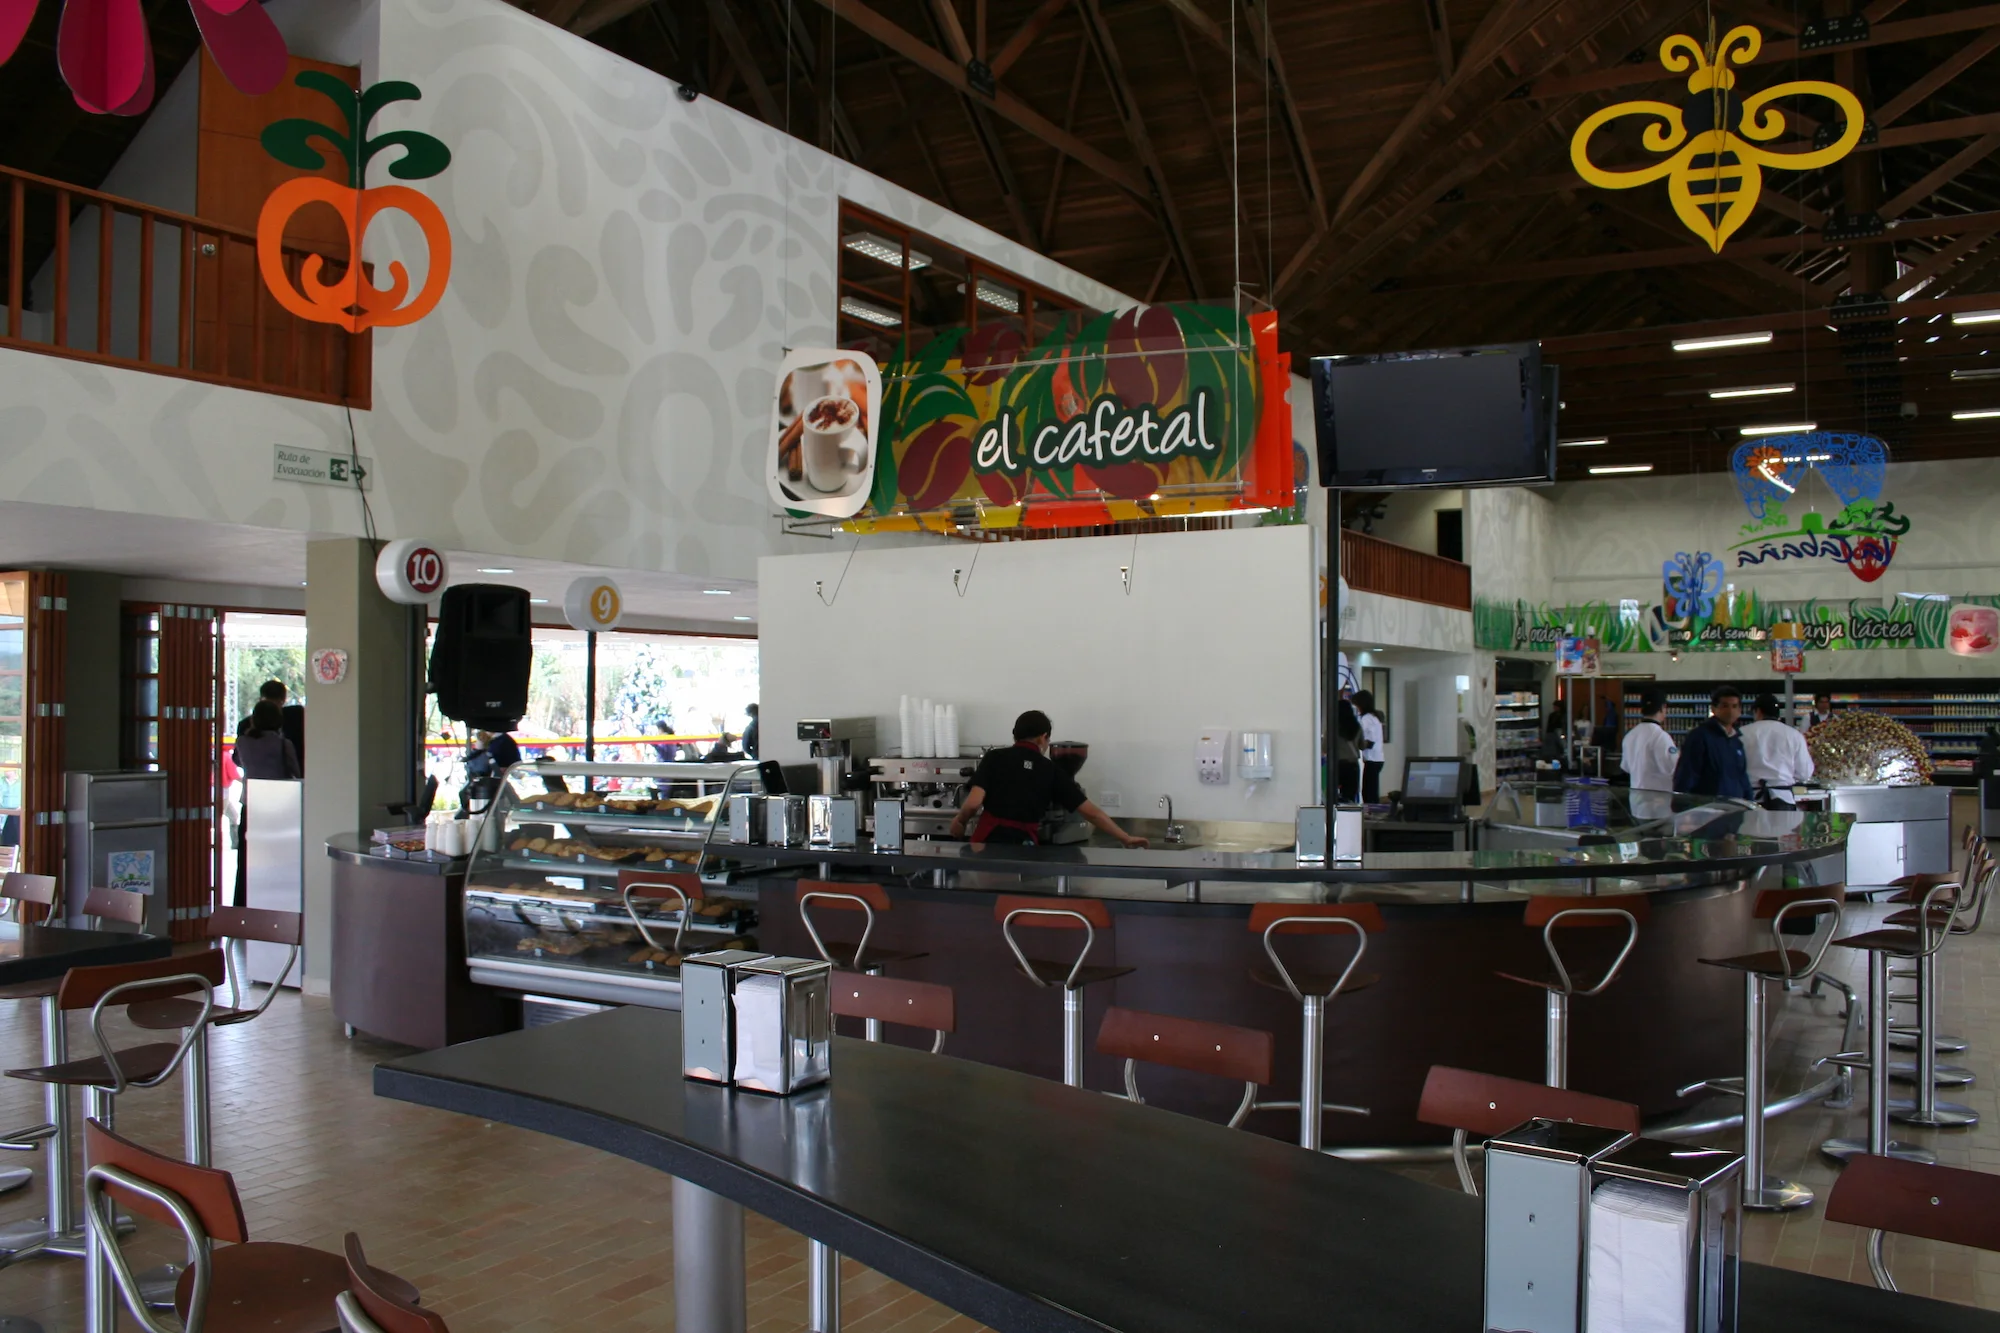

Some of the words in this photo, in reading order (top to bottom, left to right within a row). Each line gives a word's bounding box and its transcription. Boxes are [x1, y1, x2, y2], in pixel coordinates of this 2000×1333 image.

[977, 413, 1017, 470] el
[1034, 391, 1215, 461] cafetal
[299, 455, 311, 465] de
[411, 553, 440, 586] 10
[598, 589, 612, 620] 9
[1516, 621, 1527, 641] el
[1701, 625, 1722, 640] del
[1852, 619, 1915, 639] láctea
